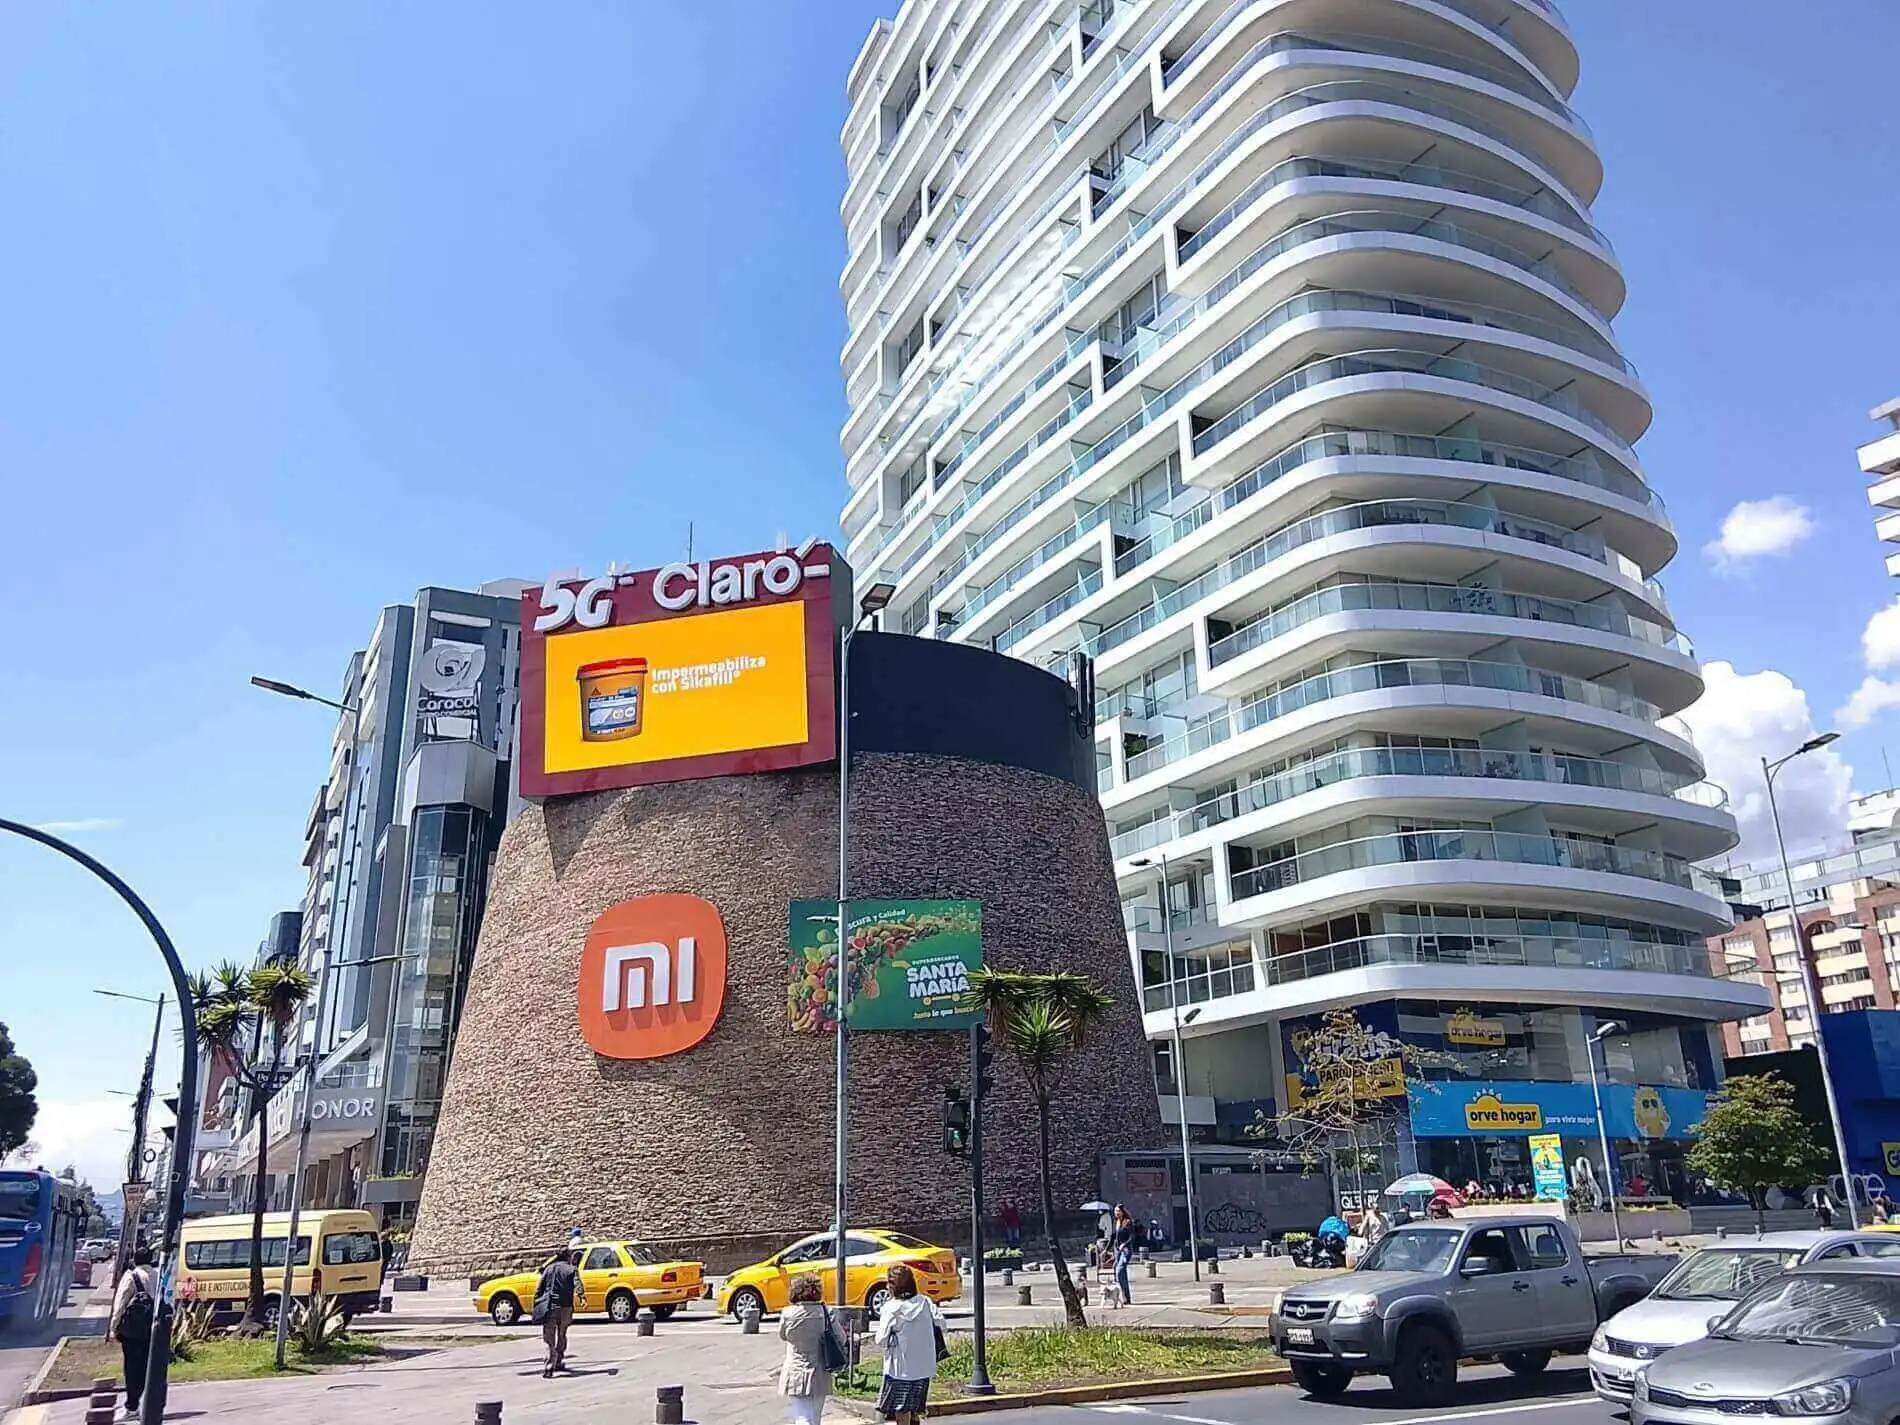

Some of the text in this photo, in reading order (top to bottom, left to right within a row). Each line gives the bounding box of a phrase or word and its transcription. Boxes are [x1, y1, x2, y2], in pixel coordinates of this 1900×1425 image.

[652, 555, 800, 610] Claro
[652, 656, 767, 683] Impermeabiliza
[652, 679, 677, 694] con
[907, 960, 968, 982] SANTA
[1470, 1110, 1497, 1122] orve
[1499, 1108, 1537, 1124] hogar
